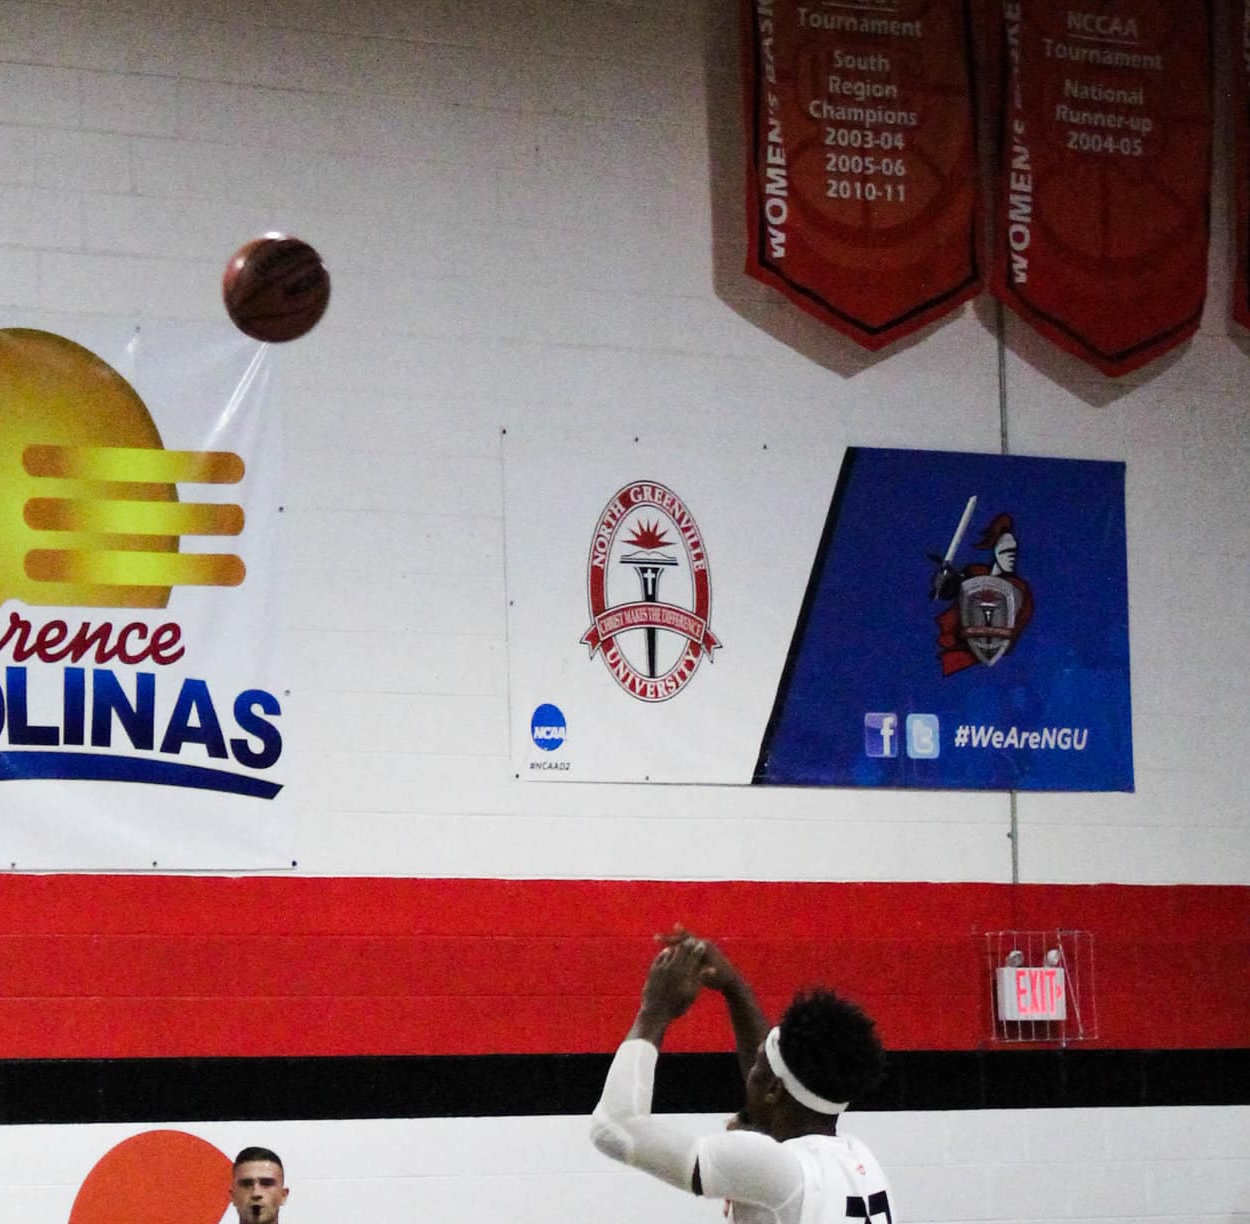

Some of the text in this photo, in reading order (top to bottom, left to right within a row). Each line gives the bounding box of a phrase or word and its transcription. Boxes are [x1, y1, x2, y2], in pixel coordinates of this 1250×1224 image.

[798, 8, 923, 37] Tournament
[1067, 10, 1139, 38] NCCAA
[833, 50, 891, 72] South
[1043, 38, 1163, 70] Tournament
[828, 75, 898, 101] Region
[1064, 79, 1144, 105] National
[808, 99, 918, 128] Champions
[1054, 105, 1153, 135] Runner-up
[824, 127, 906, 150] 2003-04
[1067, 131, 1143, 157] 2004-05
[764, 91, 789, 259] WOMEN'S
[825, 153, 906, 177] 2005-06
[826, 179, 906, 202] 2010-11
[1008, 120, 1032, 284] WOMEN'S
[592, 484, 706, 572] NORTH GREENVILLE
[606, 648, 698, 698] UNIVERSITY
[533, 726, 567, 740] NCAA
[954, 724, 1089, 751] #WeAreNGU
[1015, 969, 1057, 1015] EXIT
